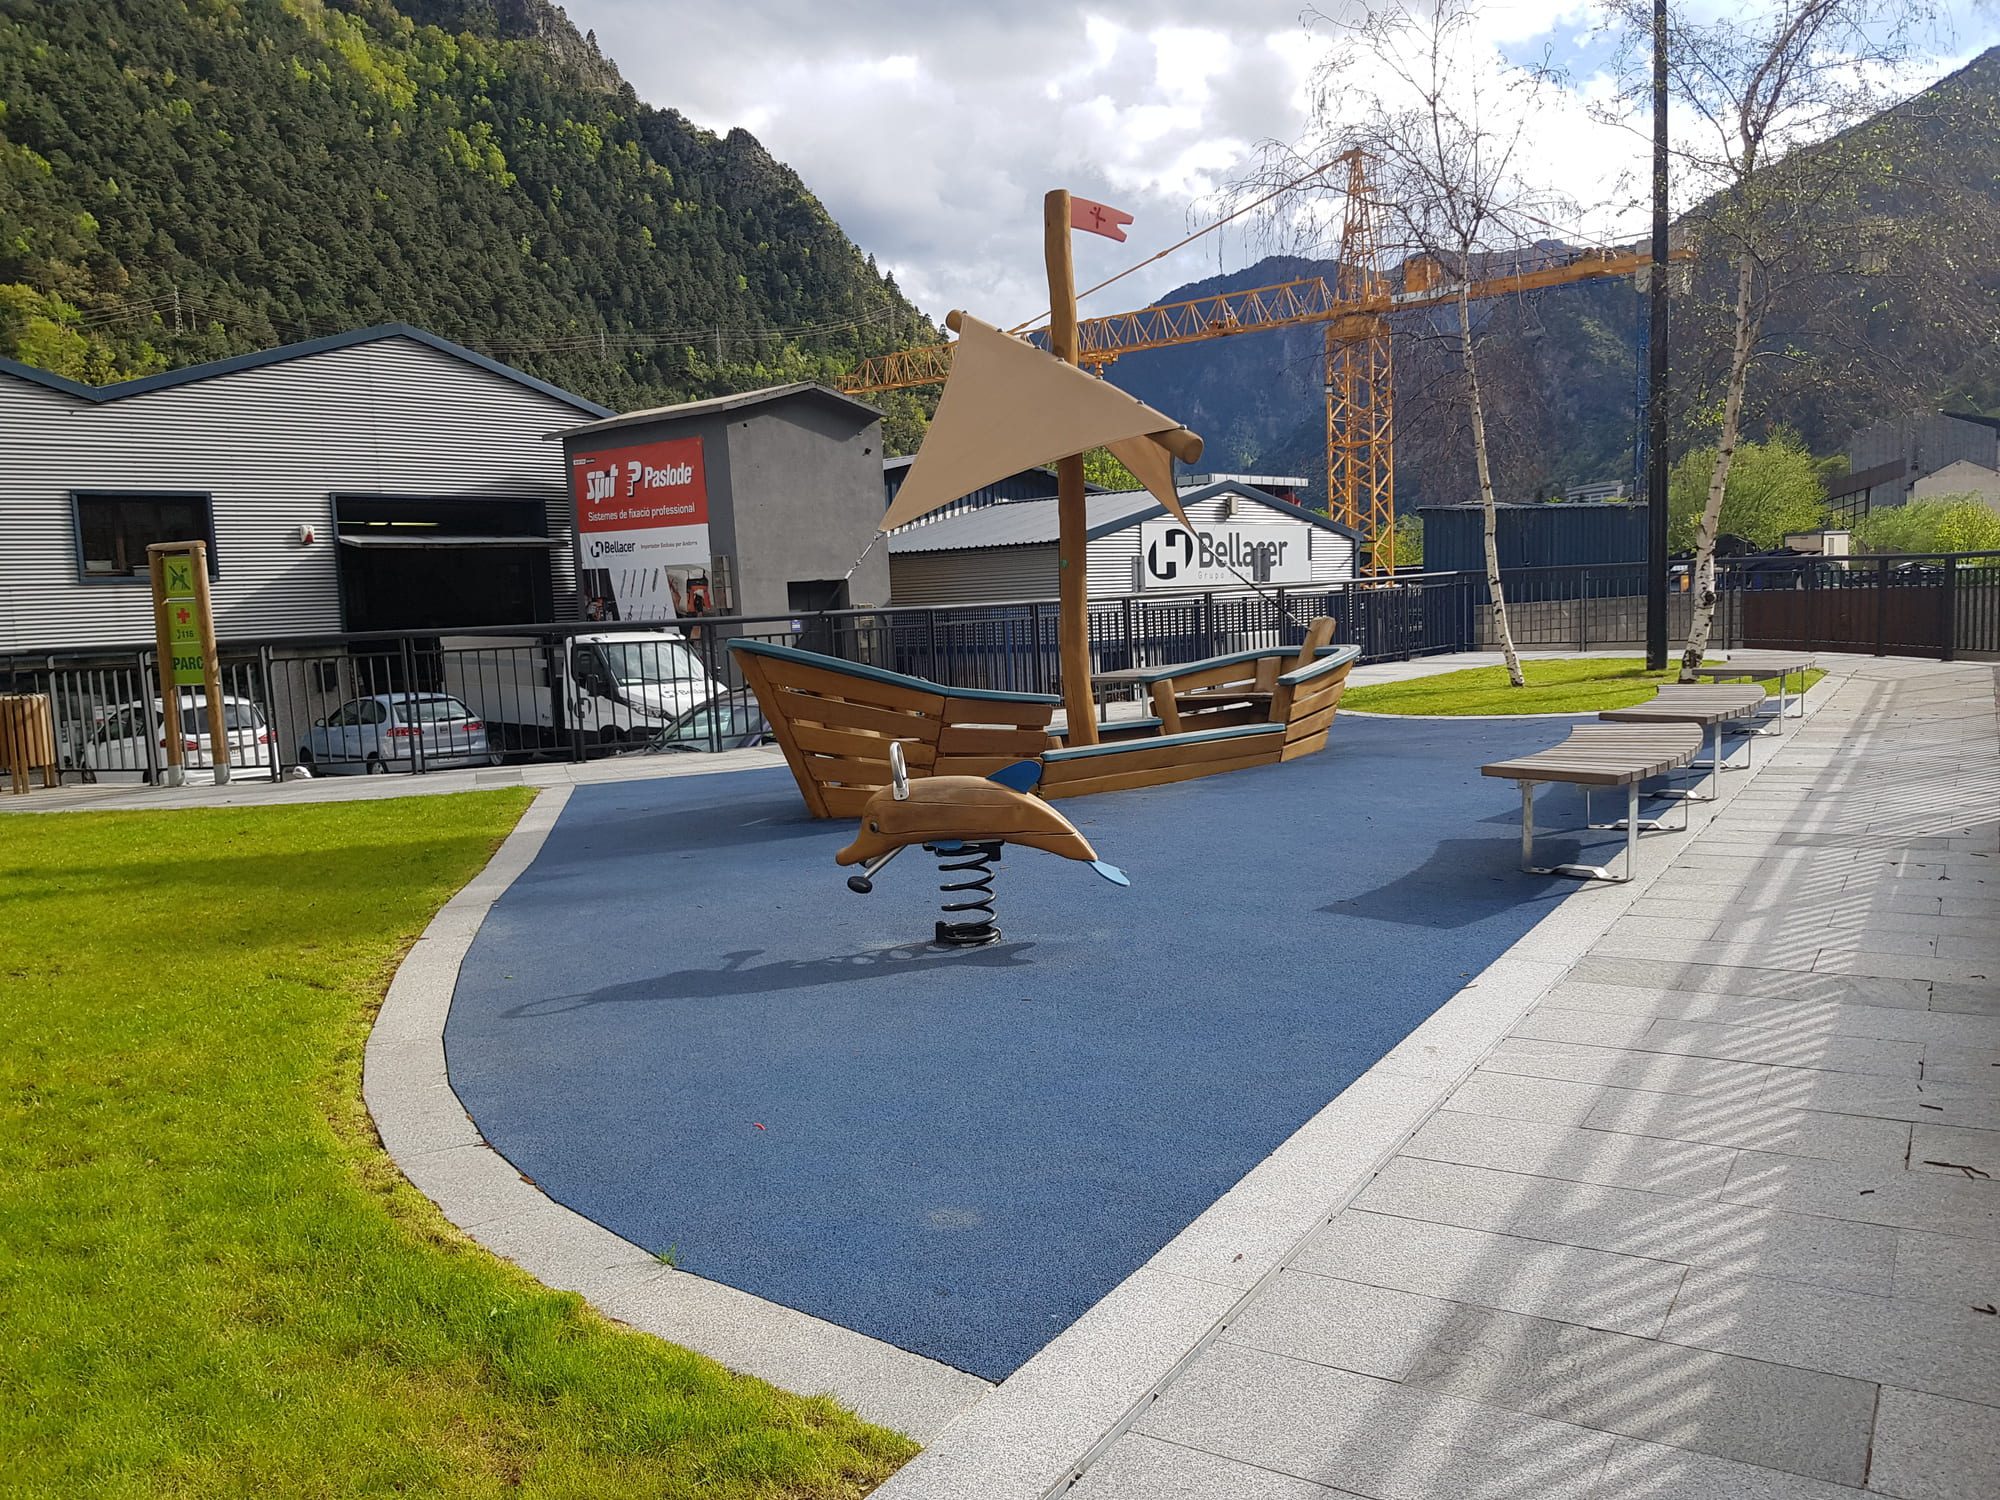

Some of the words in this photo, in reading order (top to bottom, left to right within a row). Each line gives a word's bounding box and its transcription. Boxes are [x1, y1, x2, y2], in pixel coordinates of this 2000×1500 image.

[645, 462, 692, 488] Paslode
[588, 512, 618, 521] Sistemes
[619, 509, 627, 519] de
[651, 503, 695, 518] professional
[605, 541, 636, 553] Bellacer
[1198, 532, 1288, 568] Bellaer
[173, 656, 203, 670] PARC
